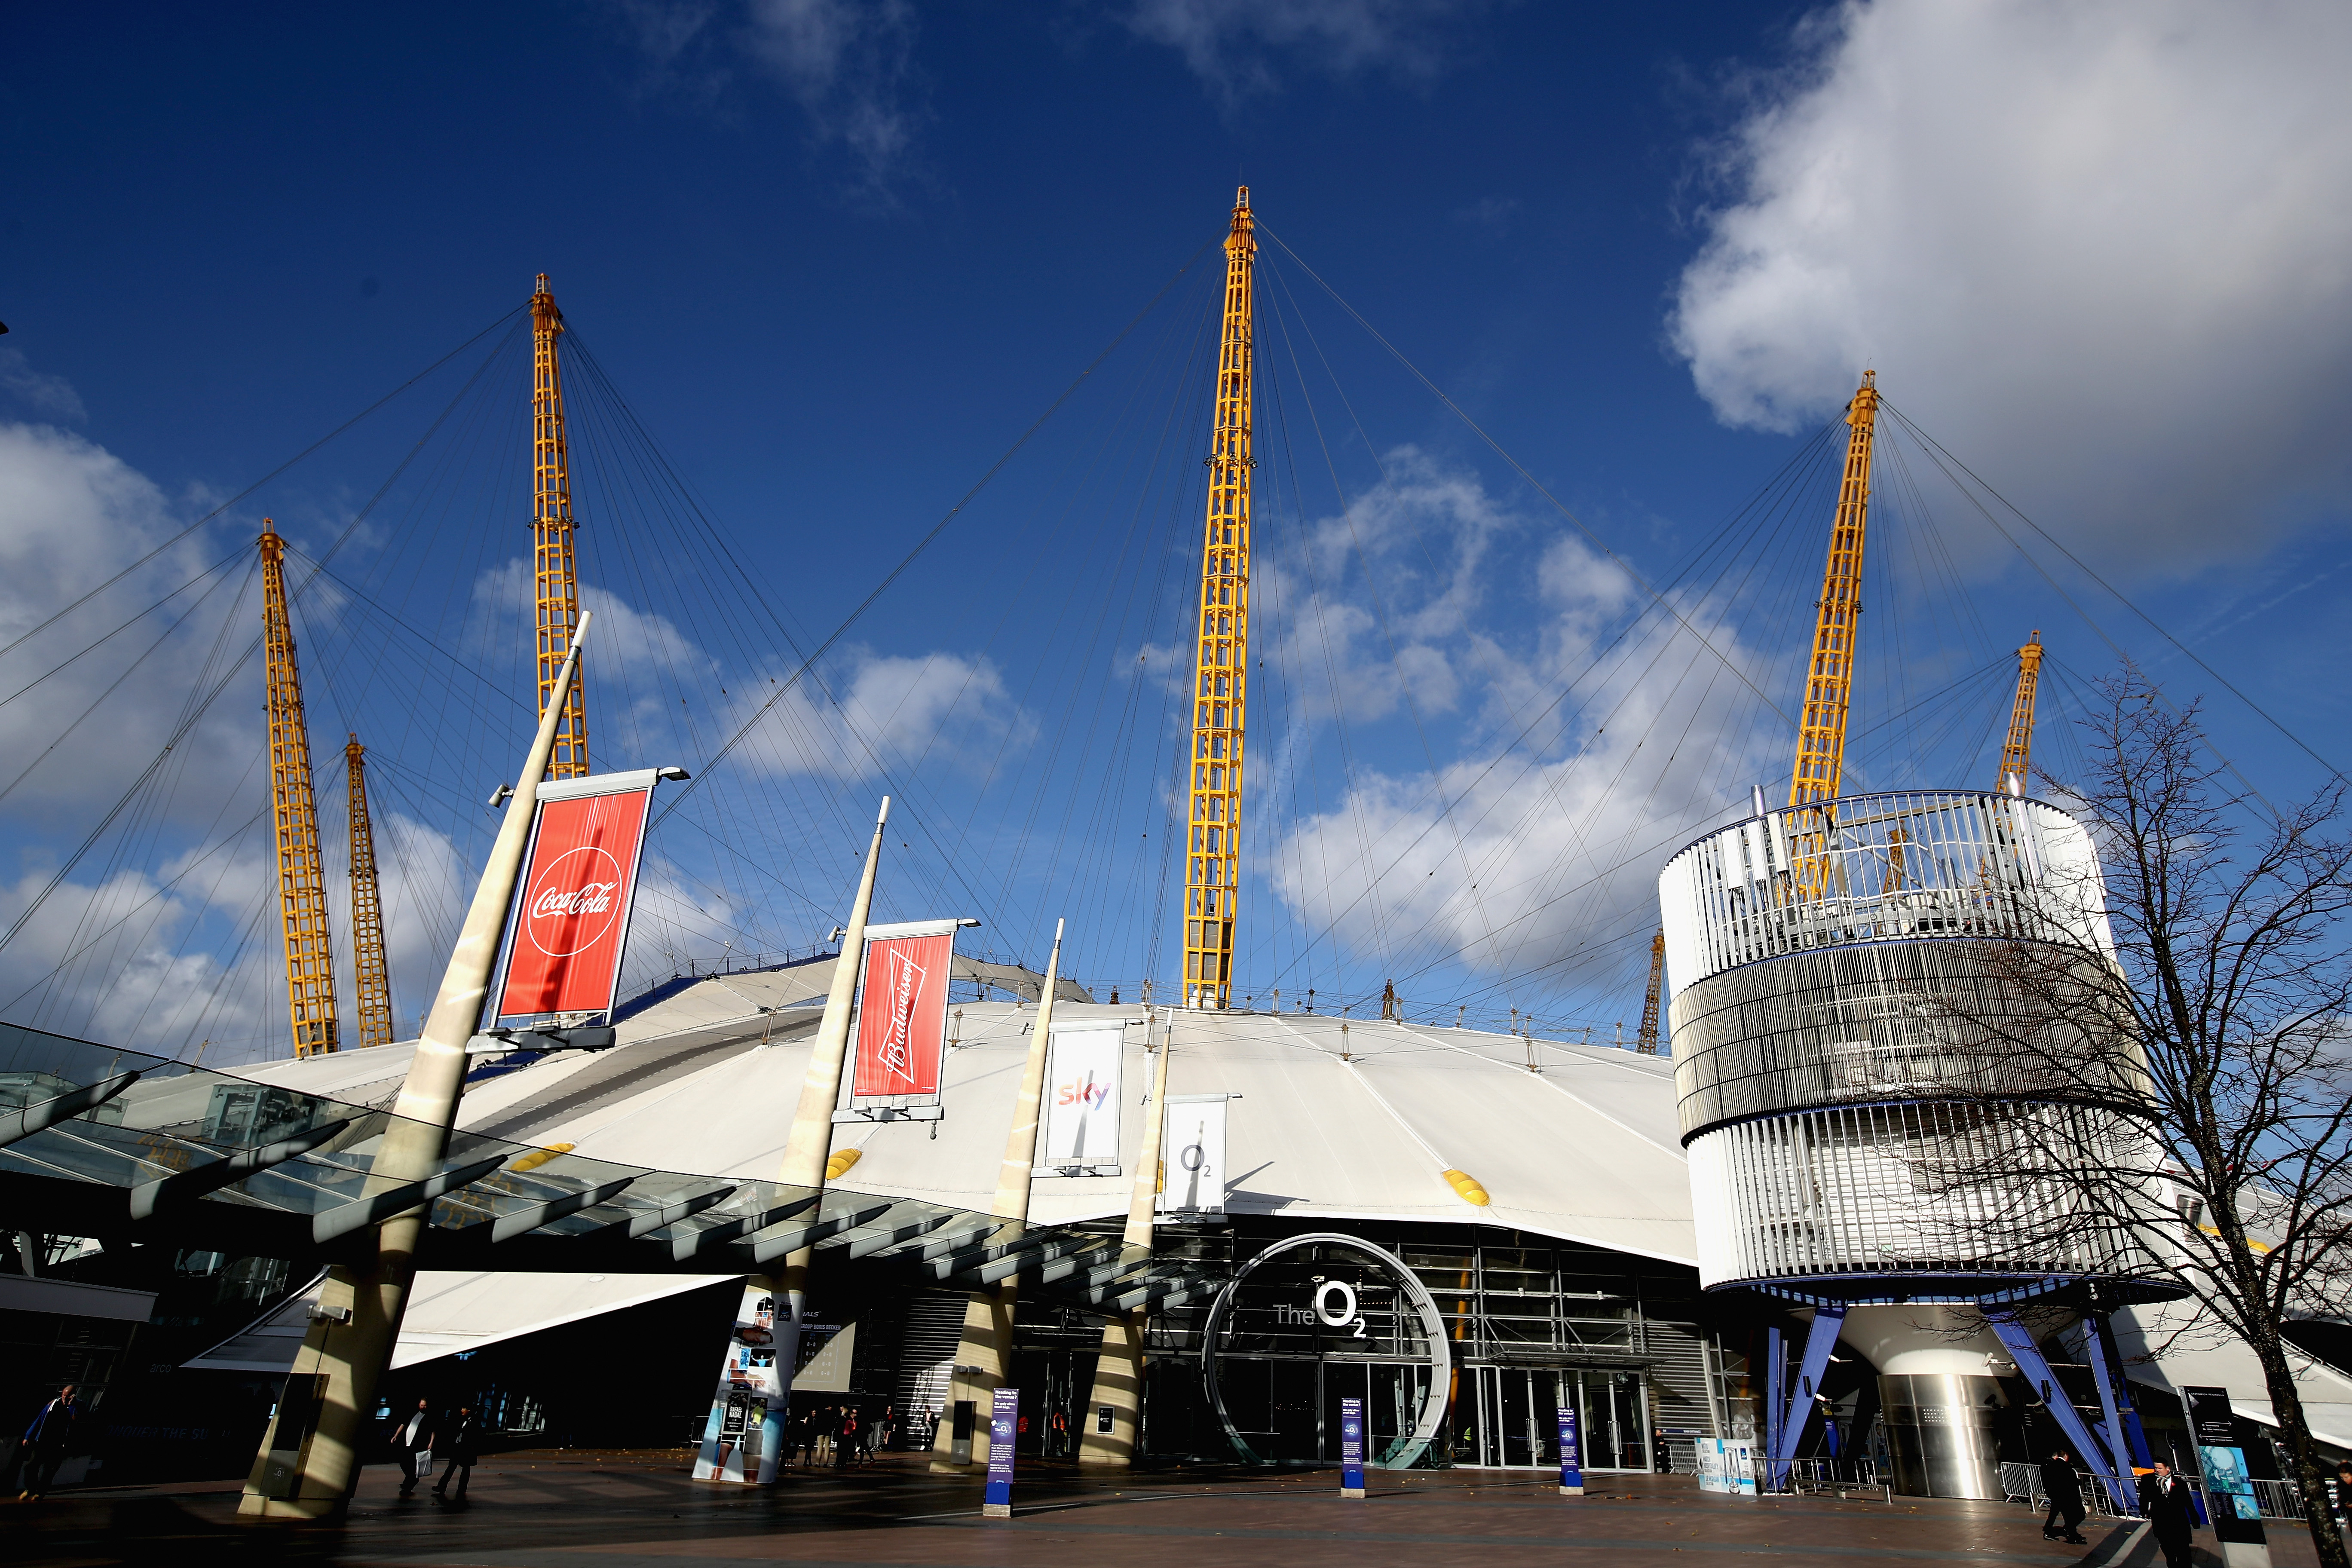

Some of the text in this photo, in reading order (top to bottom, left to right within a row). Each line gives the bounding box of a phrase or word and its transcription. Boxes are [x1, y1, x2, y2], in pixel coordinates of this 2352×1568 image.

[533, 882, 618, 918] Coca-Cola
[887, 960, 914, 1072] Budweiser
[1059, 1076, 1111, 1110] sky
[1273, 1280, 1366, 1338] The O2
[150, 1363, 171, 1372] arco
[162, 1427, 188, 1439] THE
